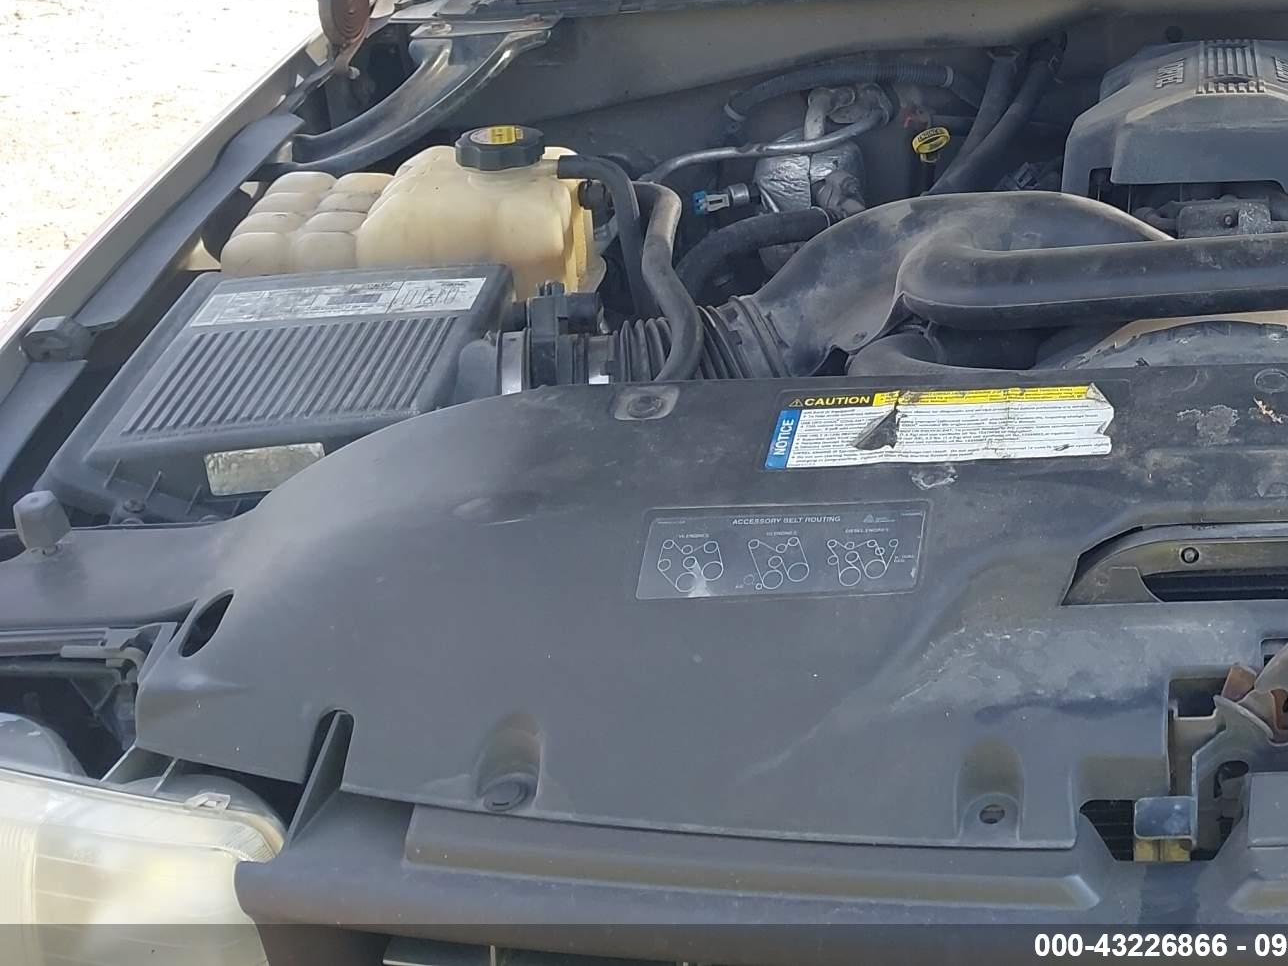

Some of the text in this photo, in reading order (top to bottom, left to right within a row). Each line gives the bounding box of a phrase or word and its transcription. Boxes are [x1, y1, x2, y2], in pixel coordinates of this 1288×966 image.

[804, 396, 870, 407] CAUTION
[773, 418, 794, 456] NOTICE
[732, 515, 841, 526] ACCESSORY BELT ROUTING
